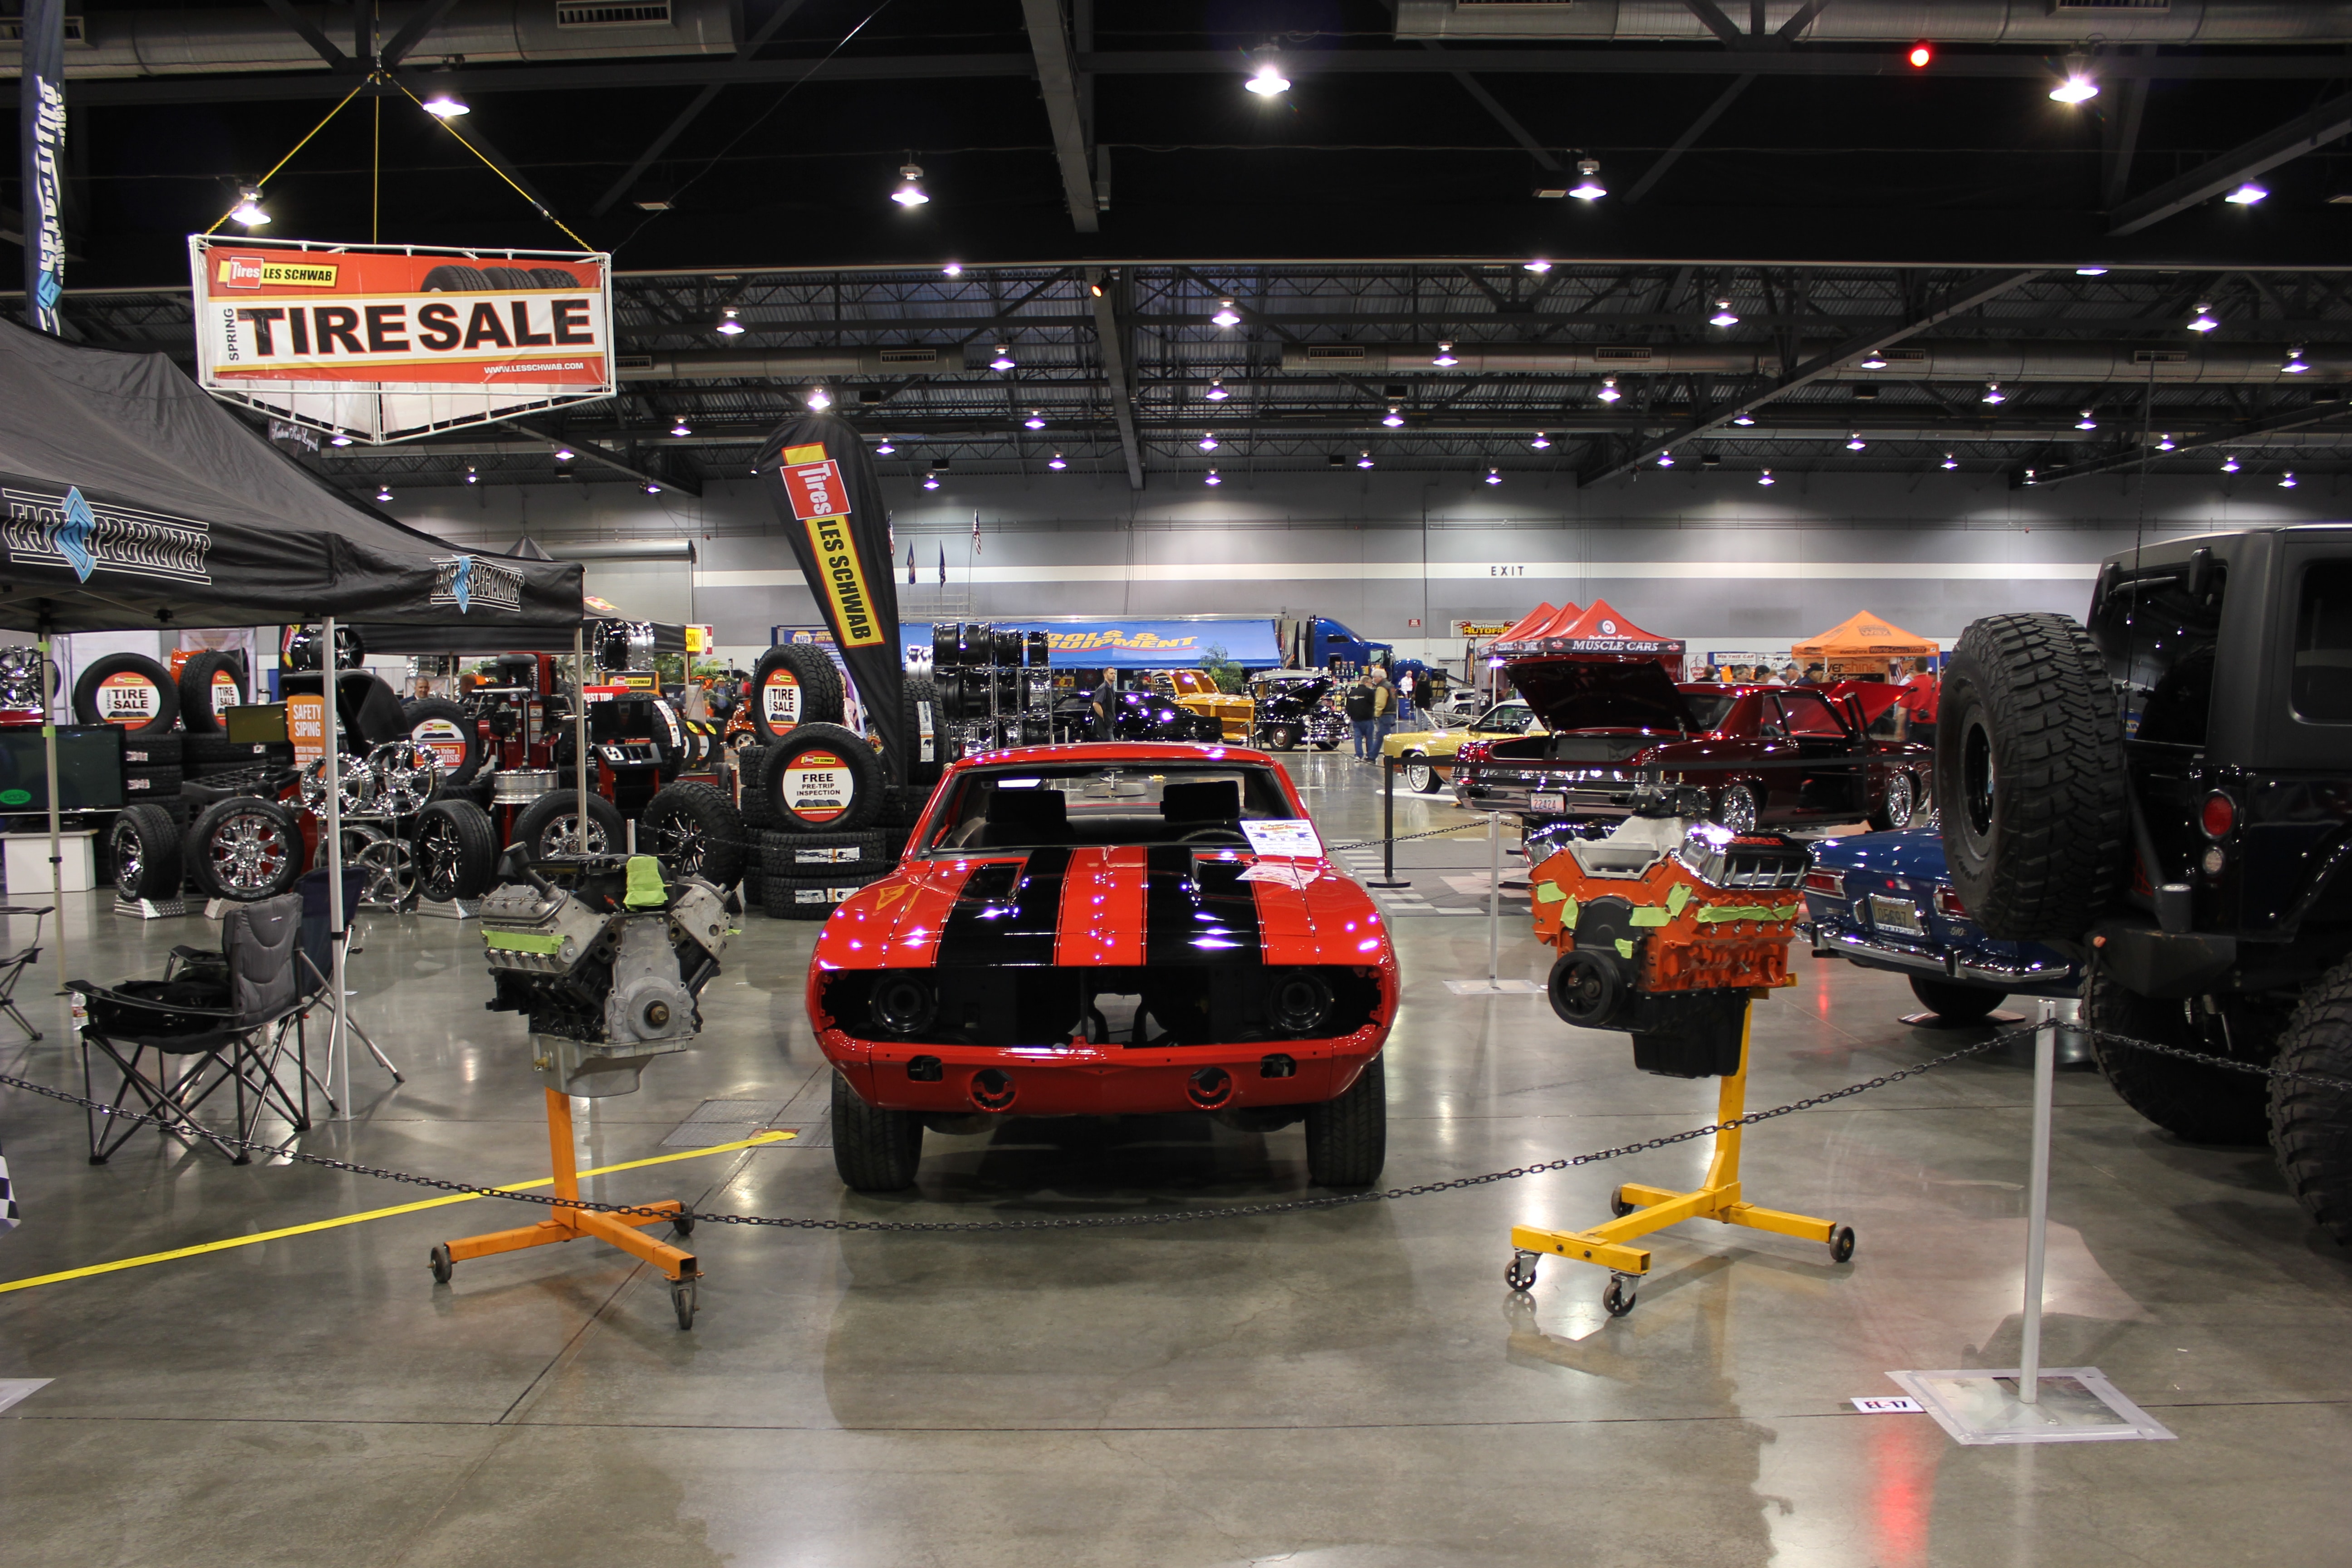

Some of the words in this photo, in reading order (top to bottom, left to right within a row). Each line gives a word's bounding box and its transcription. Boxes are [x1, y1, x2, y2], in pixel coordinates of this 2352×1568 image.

[232, 262, 260, 279] Tires
[263, 268, 281, 279] LES
[284, 270, 332, 281] SCHWAB
[223, 308, 239, 361] SPRING
[484, 363, 584, 374] WWW.LESSCHWAB.COM
[797, 463, 832, 515] Tires
[3, 502, 70, 554] FAST
[83, 514, 211, 574] SPECIALTIES
[817, 519, 844, 552] LES
[1491, 566, 1524, 576] EXIT
[828, 555, 872, 640] SCHWAB
[796, 635, 809, 643] NAPA
[1049, 629, 1124, 642] OOLS
[1572, 640, 1625, 651] MUSCLE
[1627, 642, 1659, 652] CARS
[112, 689, 148, 699] TIRE
[218, 687, 234, 696] TIRE
[772, 688, 794, 700] TIRE
[114, 700, 148, 709] SALE
[220, 697, 235, 706] SALE
[773, 701, 794, 712] SALE
[293, 704, 322, 720] SAFETY
[294, 721, 321, 737] SIPING
[802, 773, 834, 783] FREE
[1534, 799, 1556, 809] 22424
[1863, 1400, 1908, 1409] EL-17
